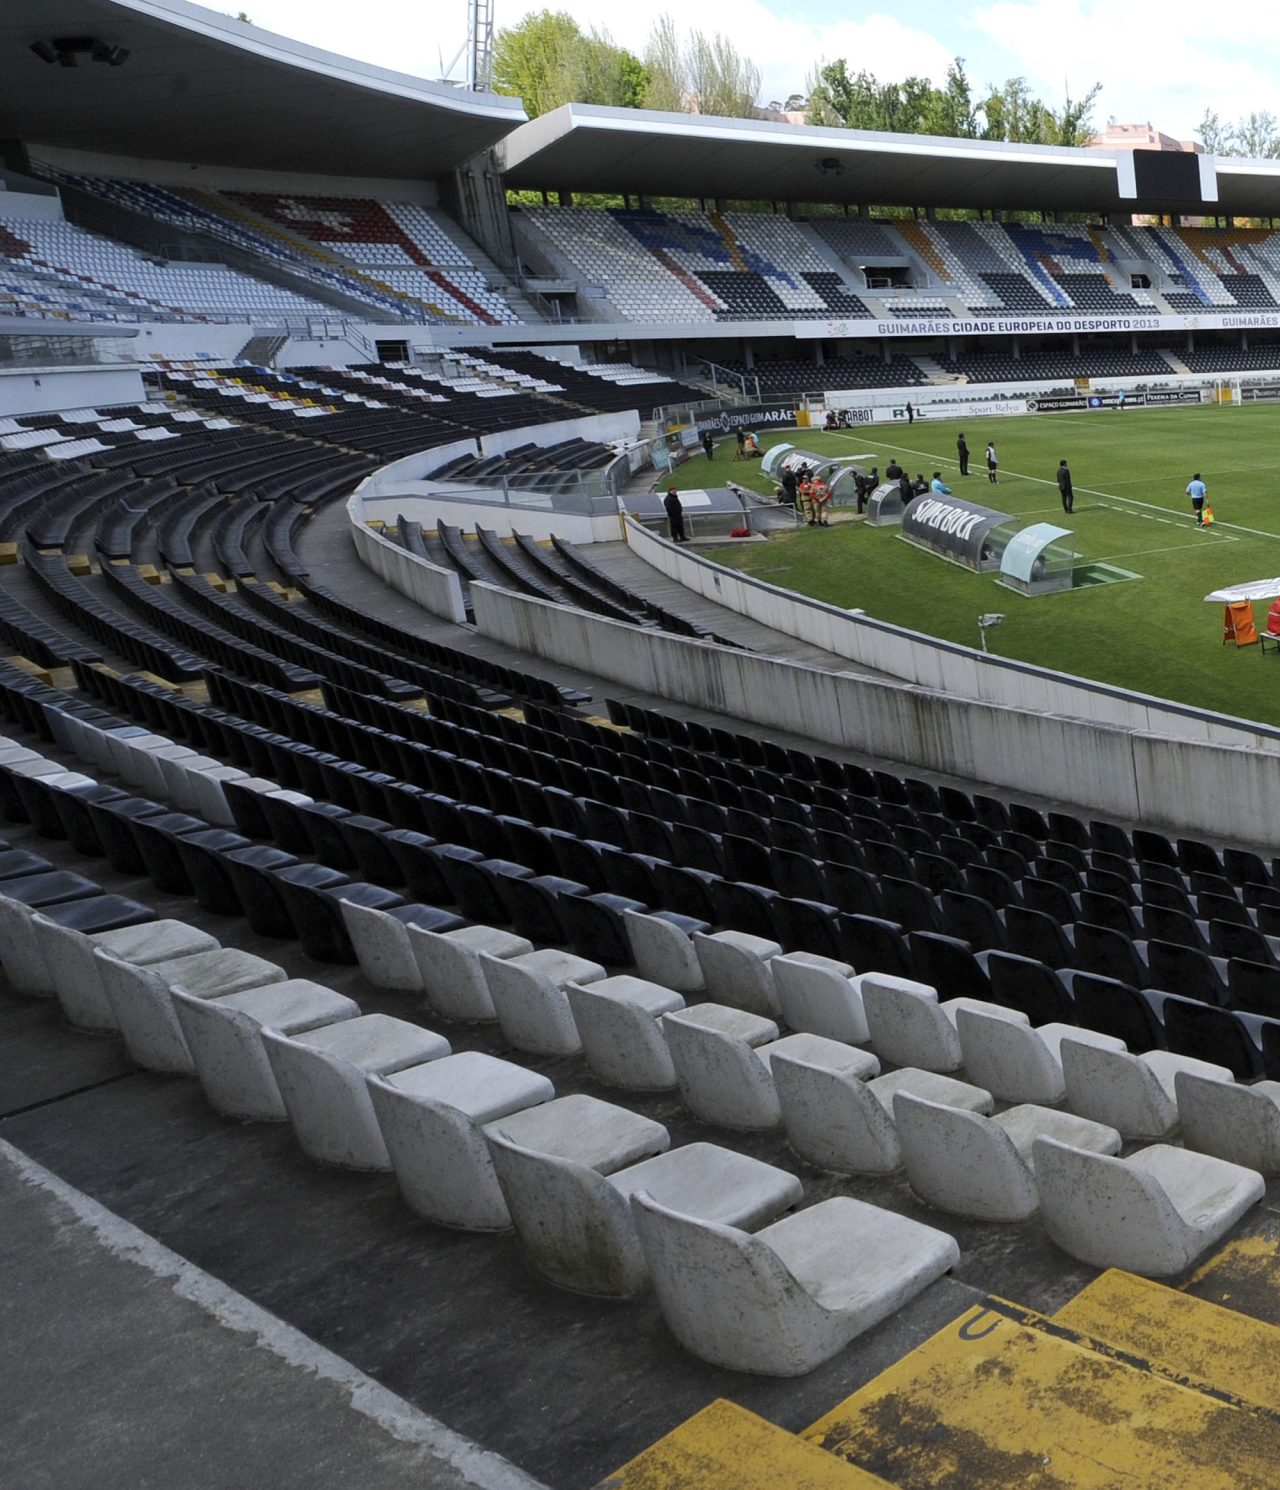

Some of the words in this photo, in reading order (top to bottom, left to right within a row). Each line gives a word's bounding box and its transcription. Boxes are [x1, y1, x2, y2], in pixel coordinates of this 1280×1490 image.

[878, 320, 950, 334] GUIMARÃES
[952, 322, 996, 333] CIDADE
[999, 320, 1054, 332] EUROPEIA
[1056, 320, 1072, 331] DO
[1074, 319, 1131, 330] DESPORTO
[1132, 319, 1160, 329] 2013
[1222, 315, 1278, 327] GUIMARÃES
[893, 407, 927, 419] RL
[912, 499, 955, 529] SUPER
[939, 508, 986, 541] BOCK
